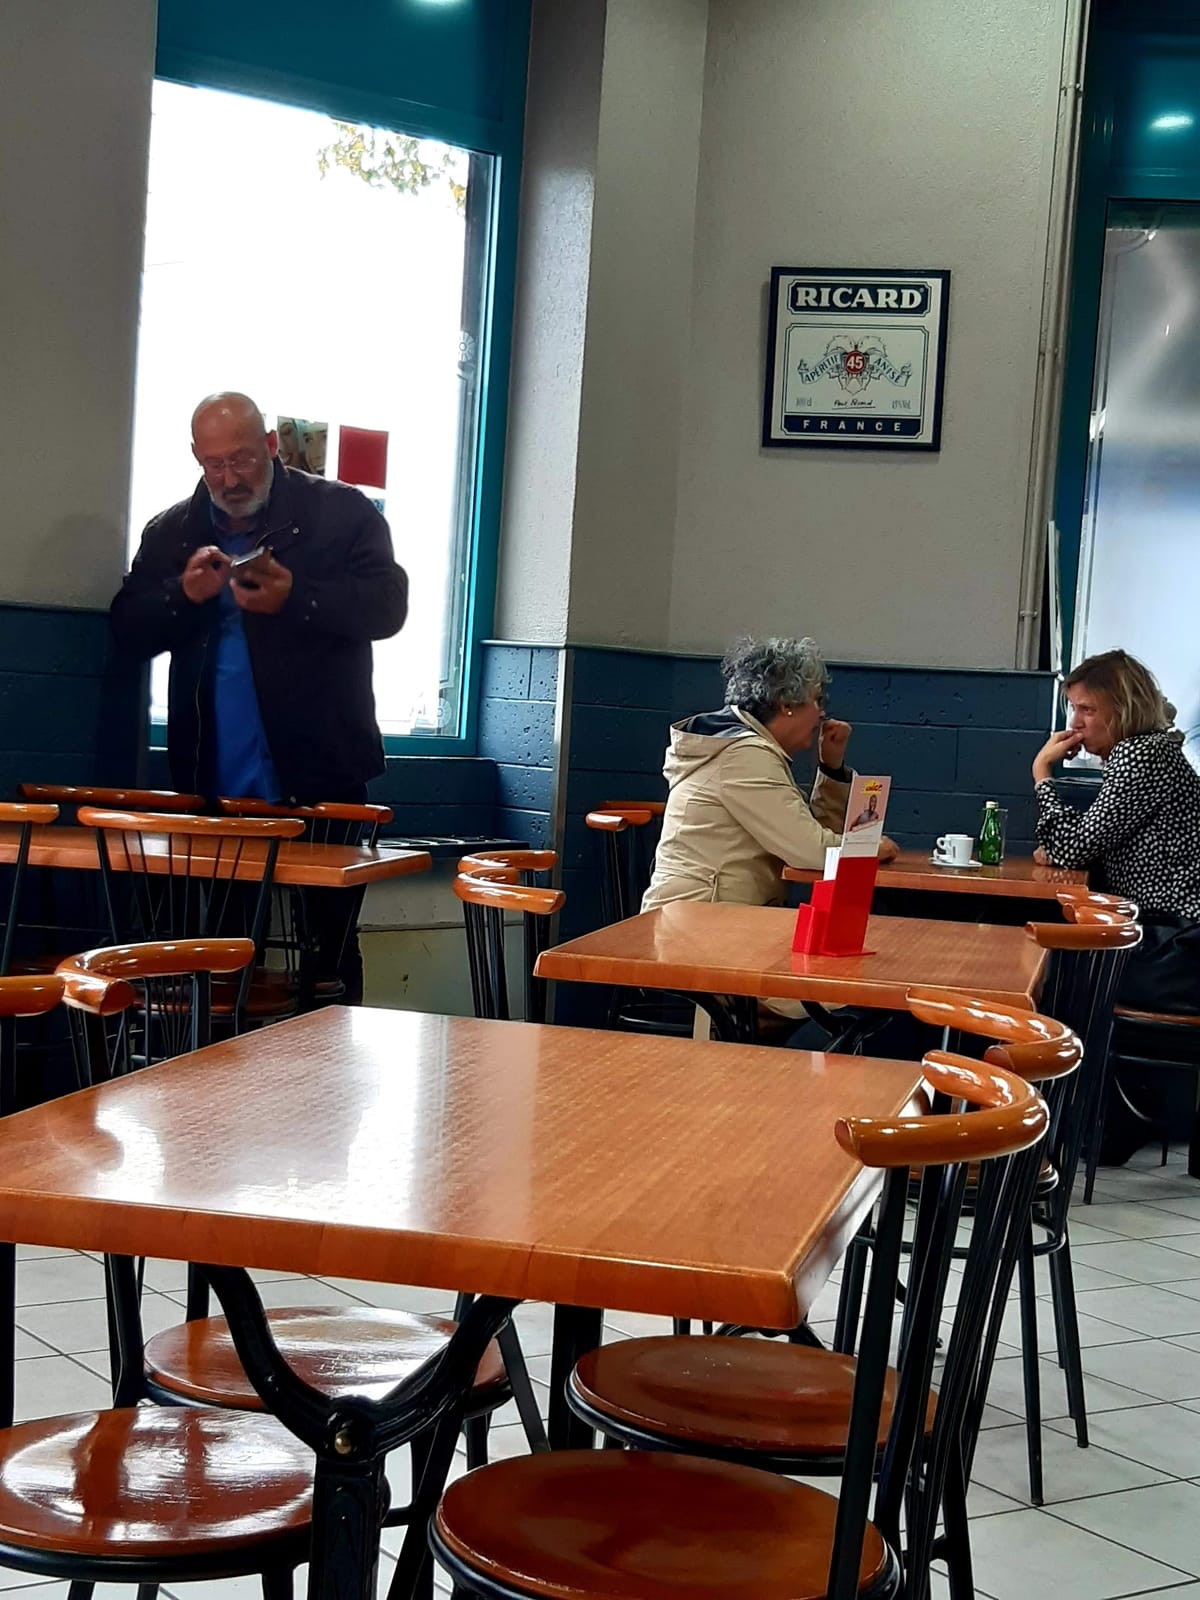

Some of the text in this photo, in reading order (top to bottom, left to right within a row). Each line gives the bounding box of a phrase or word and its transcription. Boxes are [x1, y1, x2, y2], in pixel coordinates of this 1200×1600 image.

[796, 287, 922, 309] RICARD
[846, 355, 863, 370] 45
[803, 420, 901, 431] FRANCE
